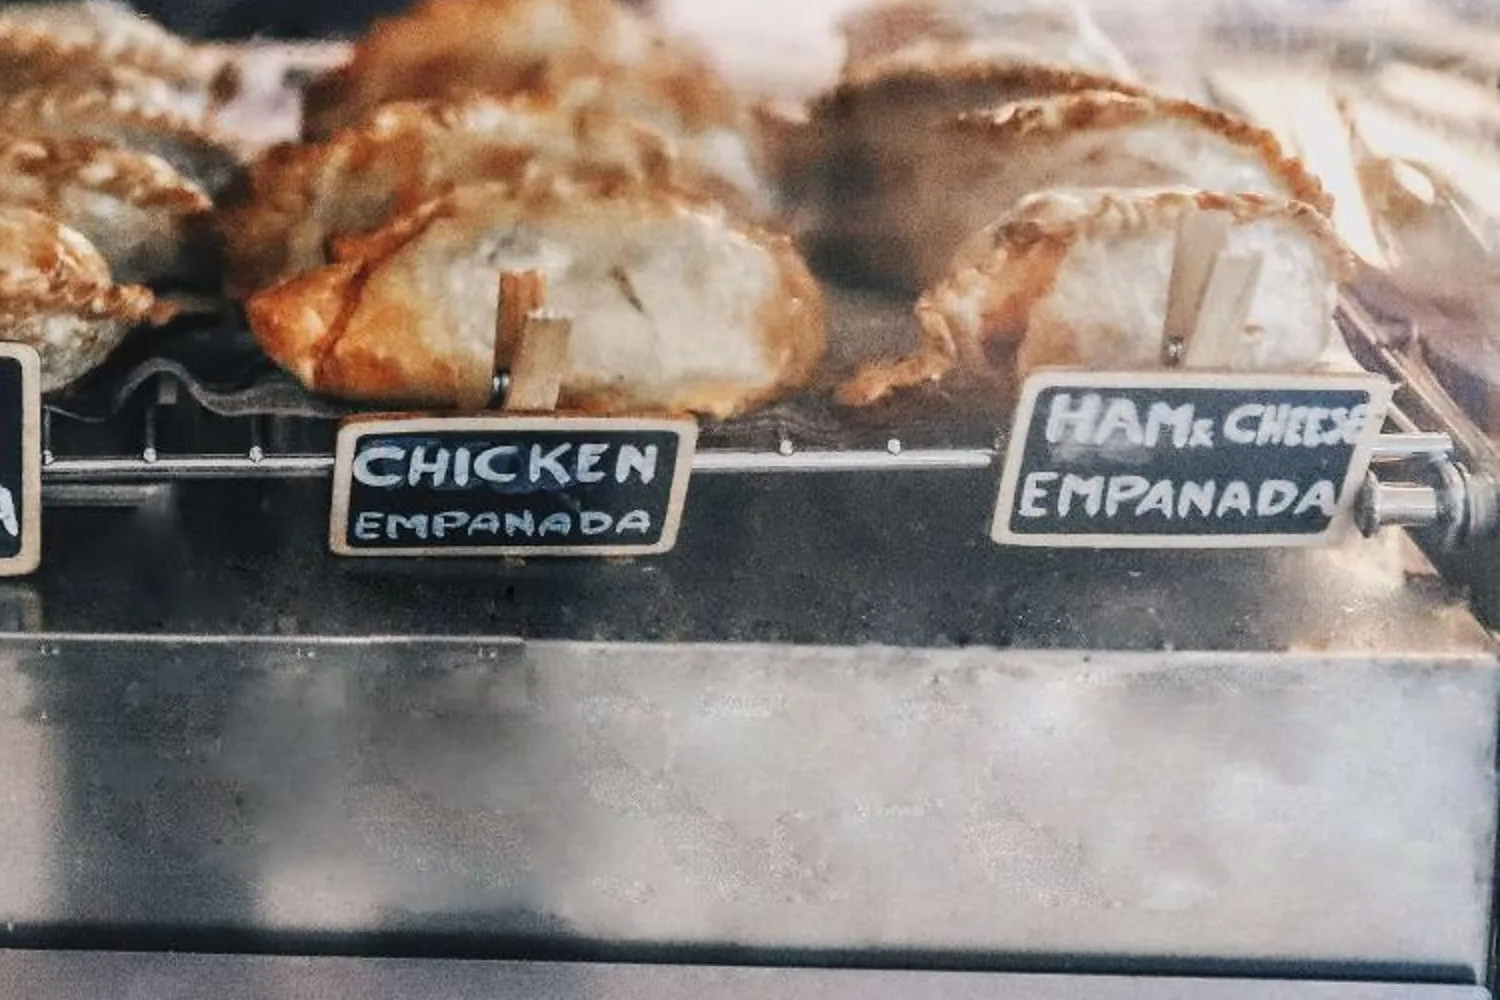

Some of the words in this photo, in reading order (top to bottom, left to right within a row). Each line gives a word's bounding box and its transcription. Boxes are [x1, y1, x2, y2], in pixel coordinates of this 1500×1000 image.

[352, 441, 658, 488] CHICKEN
[1018, 471, 1340, 520] EMPANADA
[355, 508, 652, 540] EMPANADA
